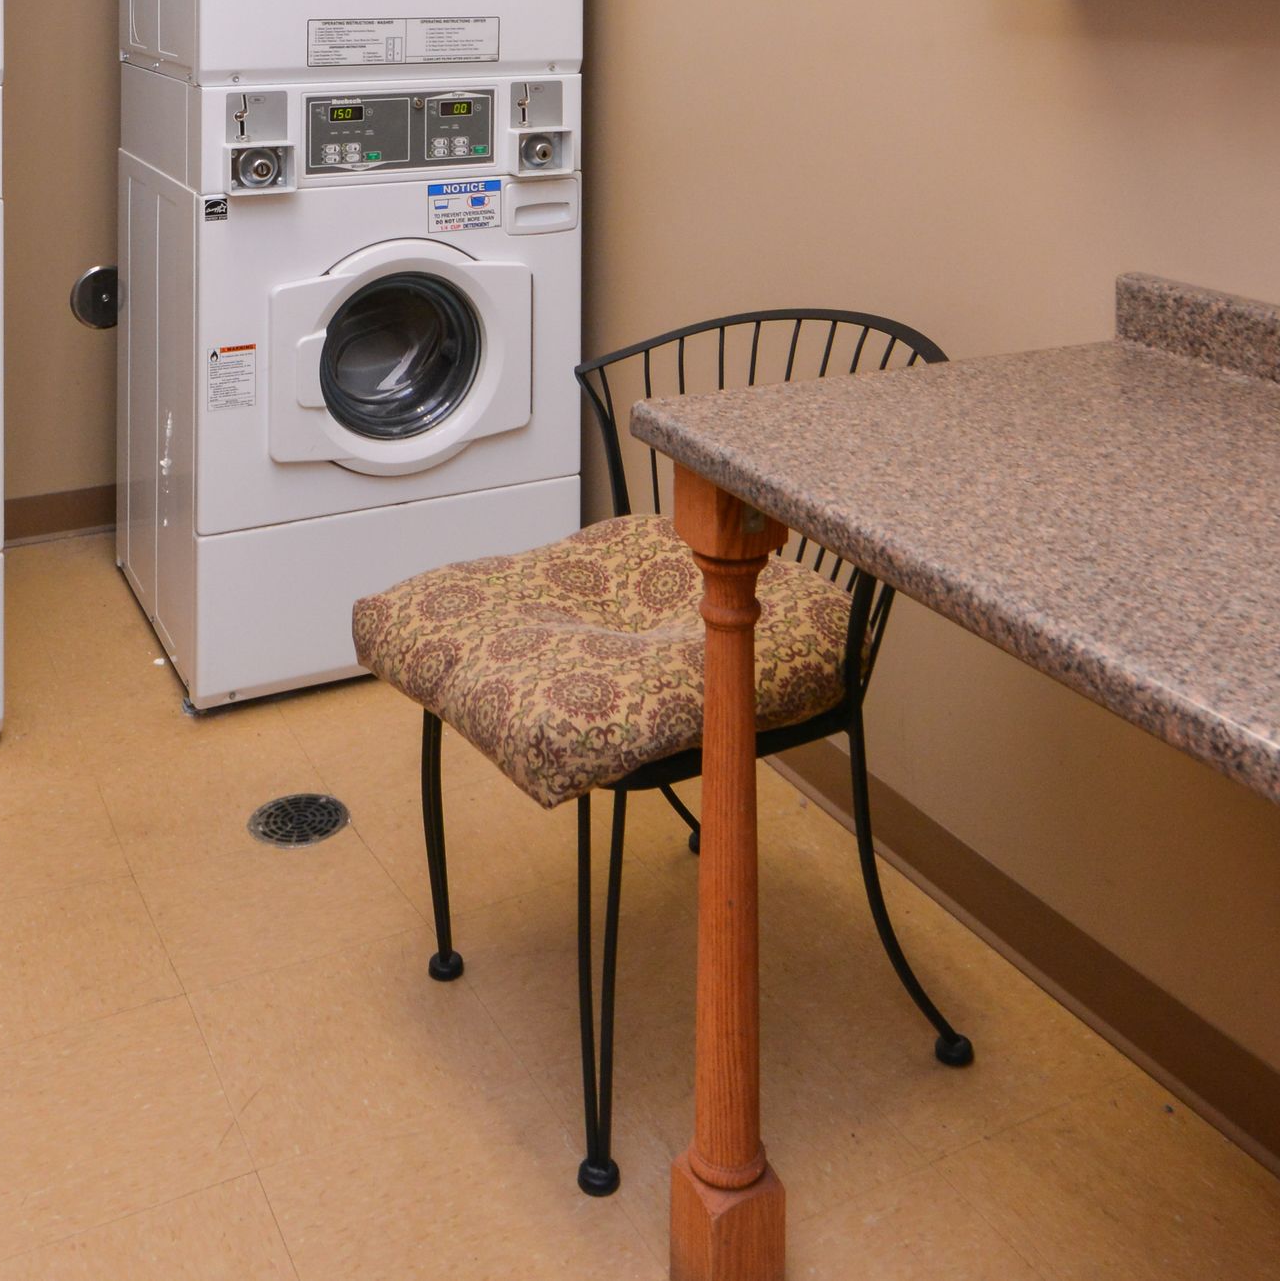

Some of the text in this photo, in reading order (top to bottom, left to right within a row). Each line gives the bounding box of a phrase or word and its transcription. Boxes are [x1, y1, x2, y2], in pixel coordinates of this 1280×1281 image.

[333, 108, 352, 119] 150
[453, 103, 467, 114] 00
[443, 182, 486, 194] NOTICE
